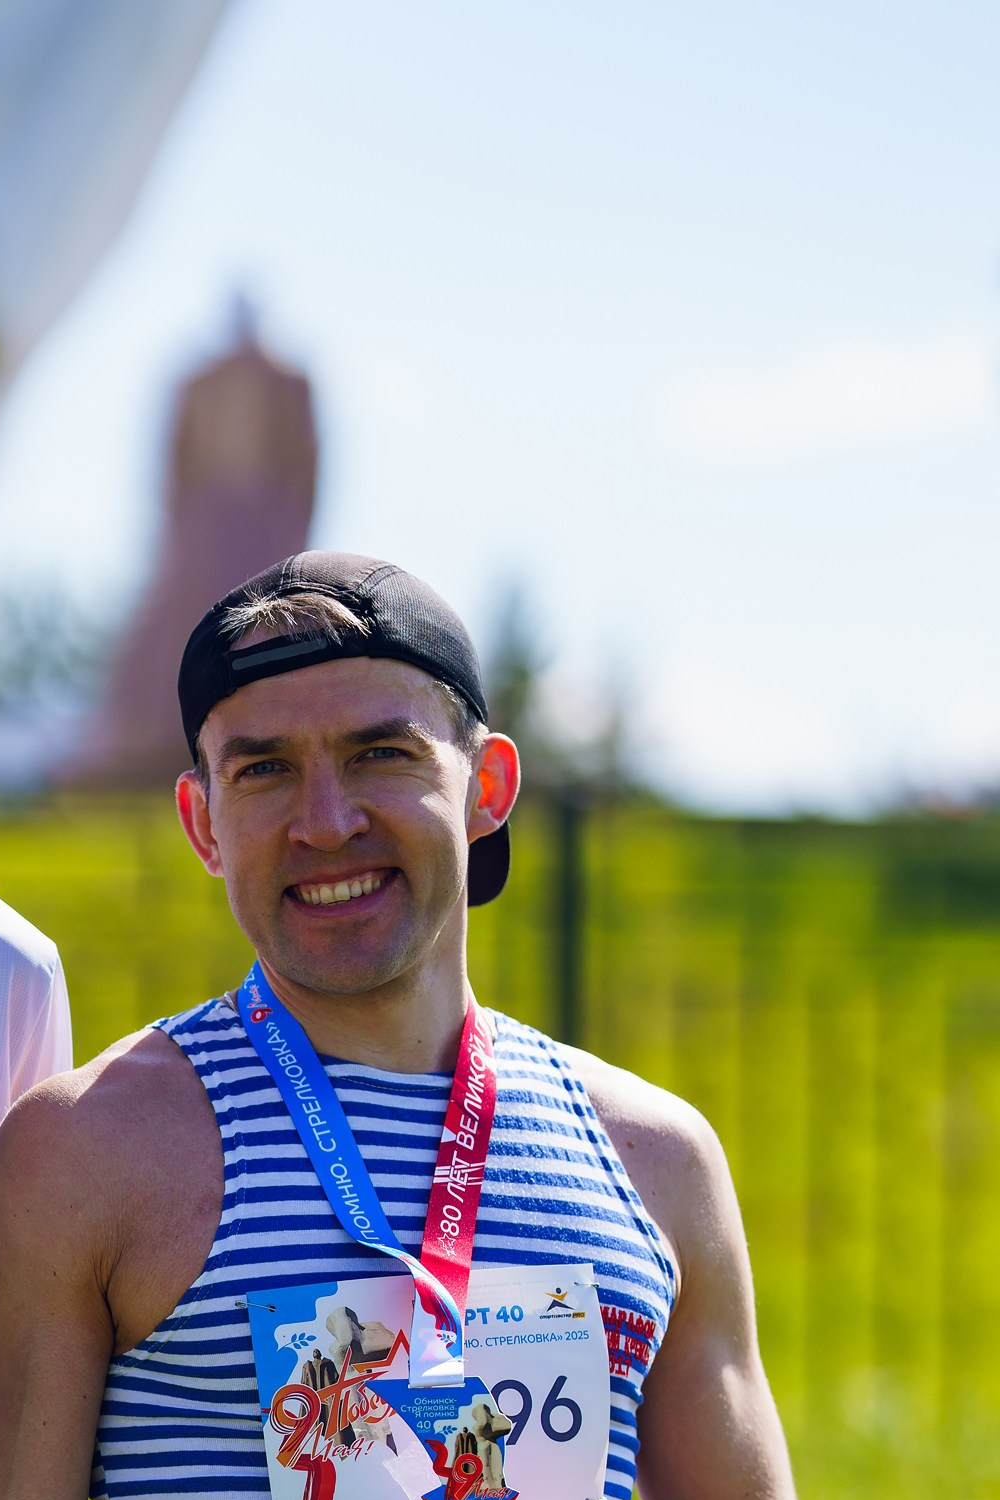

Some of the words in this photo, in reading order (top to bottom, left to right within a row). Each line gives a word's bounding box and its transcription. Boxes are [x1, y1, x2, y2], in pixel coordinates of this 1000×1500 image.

[266, 1021, 337, 1152] СТРЕЛКОВКА»
[447, 1151, 471, 1202] ЛЕТ
[329, 1156, 380, 1240] ПОМНЮ.
[440, 1204, 462, 1237] 80
[496, 1305, 524, 1323] 40
[485, 1332, 563, 1347] СТРЕЛКОВКА»
[565, 1330, 590, 1341] 2025
[414, 1397, 457, 1405] Обнинск-
[490, 1376, 583, 1446] 96
[270, 1384, 322, 1468] 9
[416, 1420, 431, 1429] 40
